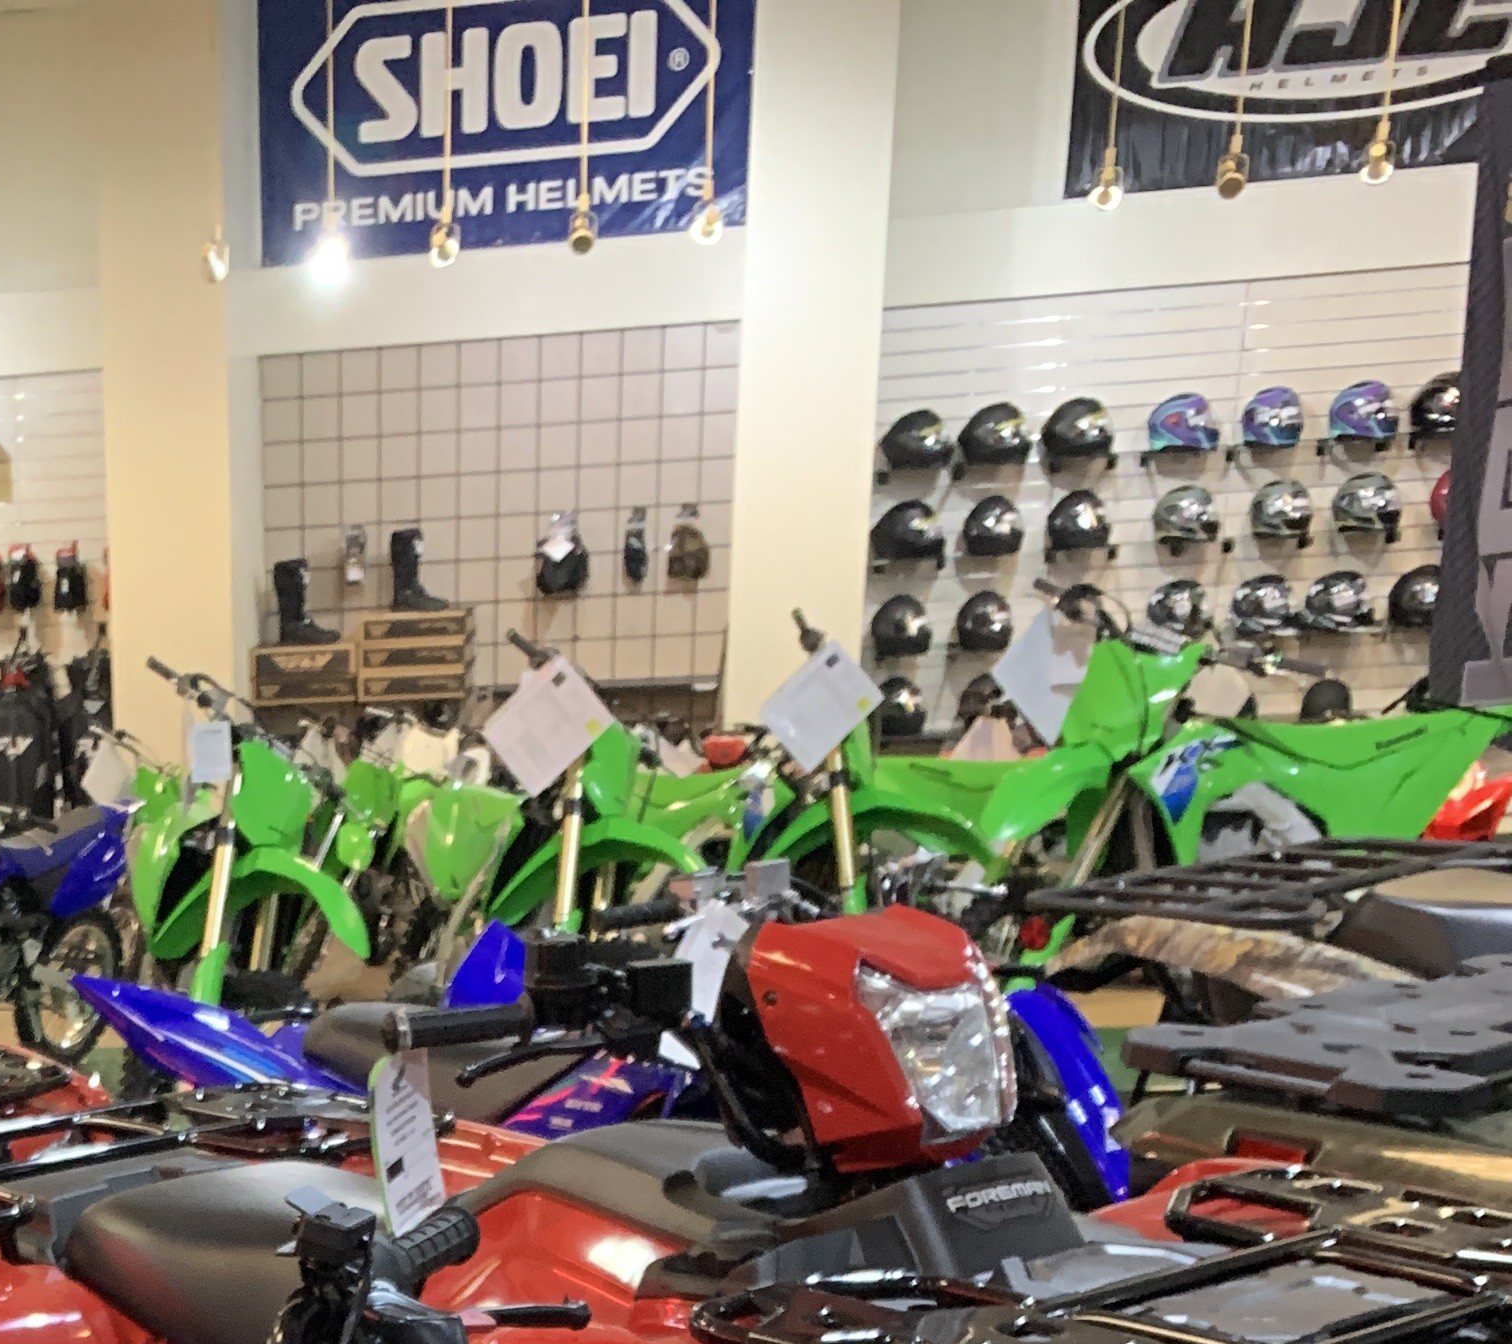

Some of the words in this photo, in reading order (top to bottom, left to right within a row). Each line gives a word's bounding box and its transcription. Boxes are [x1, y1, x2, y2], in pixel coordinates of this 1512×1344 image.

[353, 9, 659, 145] SHOEI
[1248, 65, 1430, 92] HELMETS
[292, 185, 496, 233] PREMIUM
[505, 165, 715, 214] HELMETS
[946, 1180, 1052, 1214] FOREMAN
